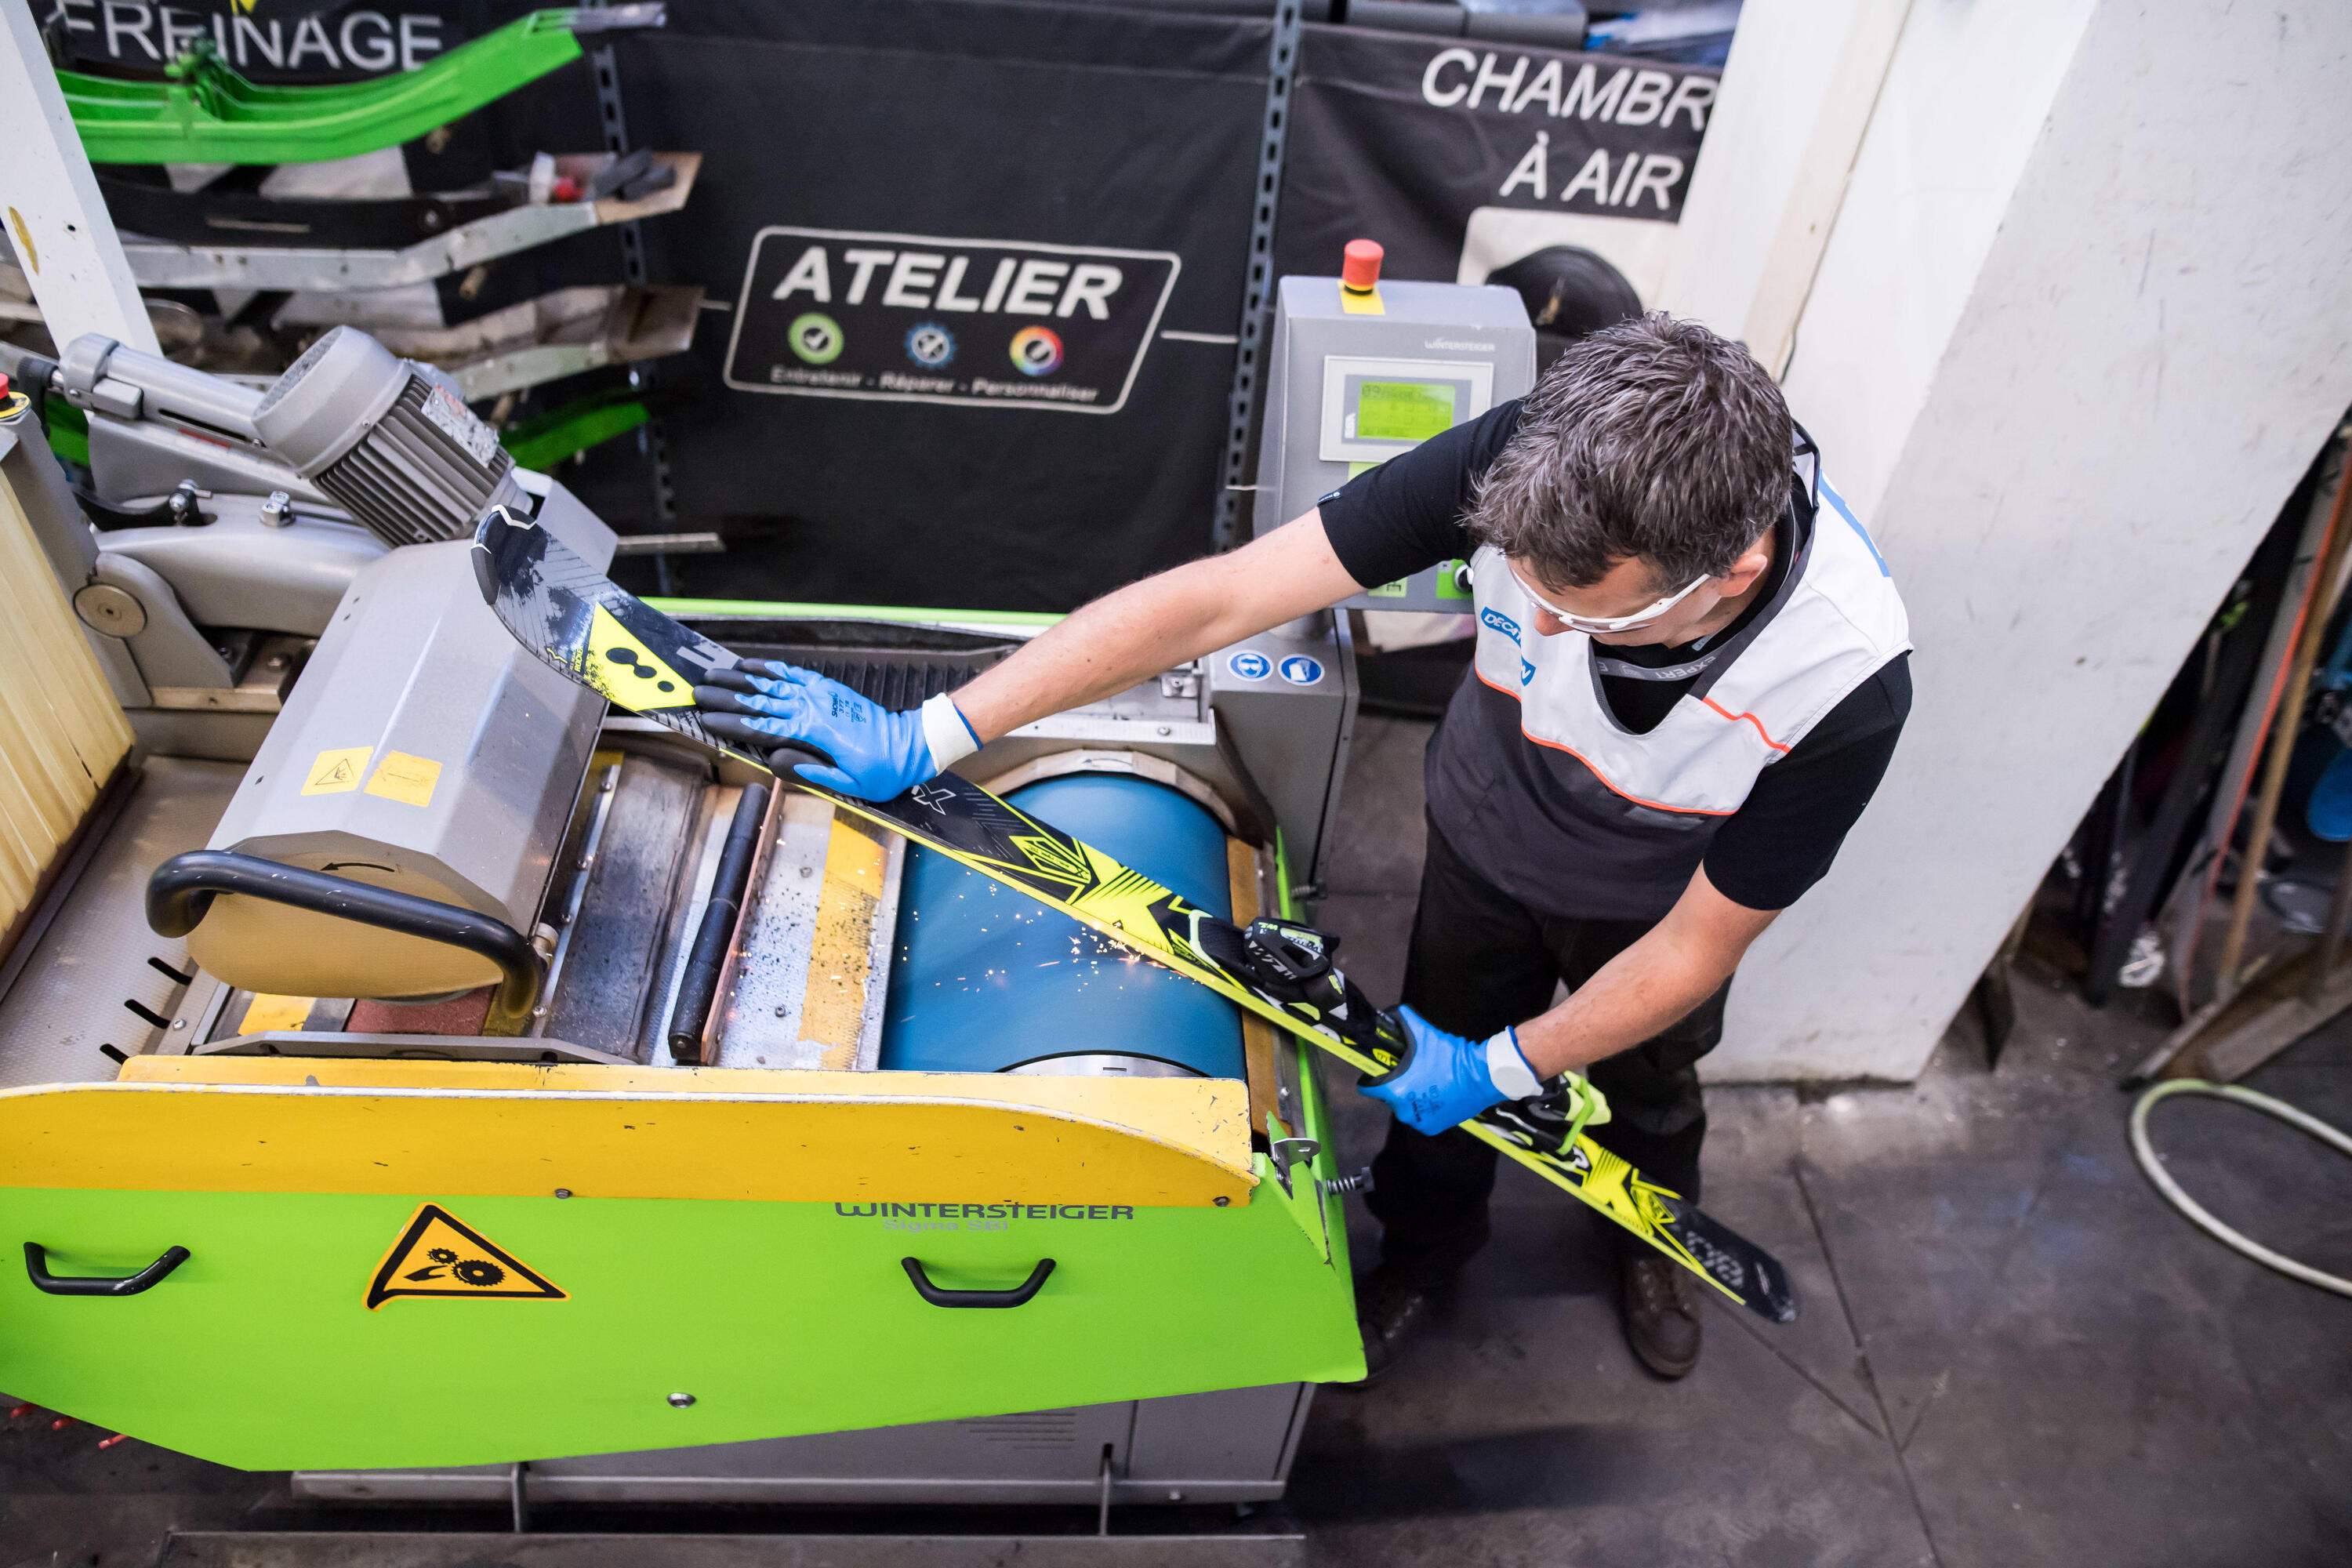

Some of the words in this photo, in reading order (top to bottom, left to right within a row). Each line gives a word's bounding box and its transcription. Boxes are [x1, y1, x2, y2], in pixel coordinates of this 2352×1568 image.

[56, 0, 444, 72] FREINAGE
[1421, 47, 1718, 133] CHAMBR
[1560, 149, 1685, 210] AIR
[771, 245, 1123, 320] ATELIER
[1656, 655, 1717, 679] EXPERT
[834, 1202, 1134, 1220] WINTERSTEIGER
[883, 1218, 959, 1233] Sigma
